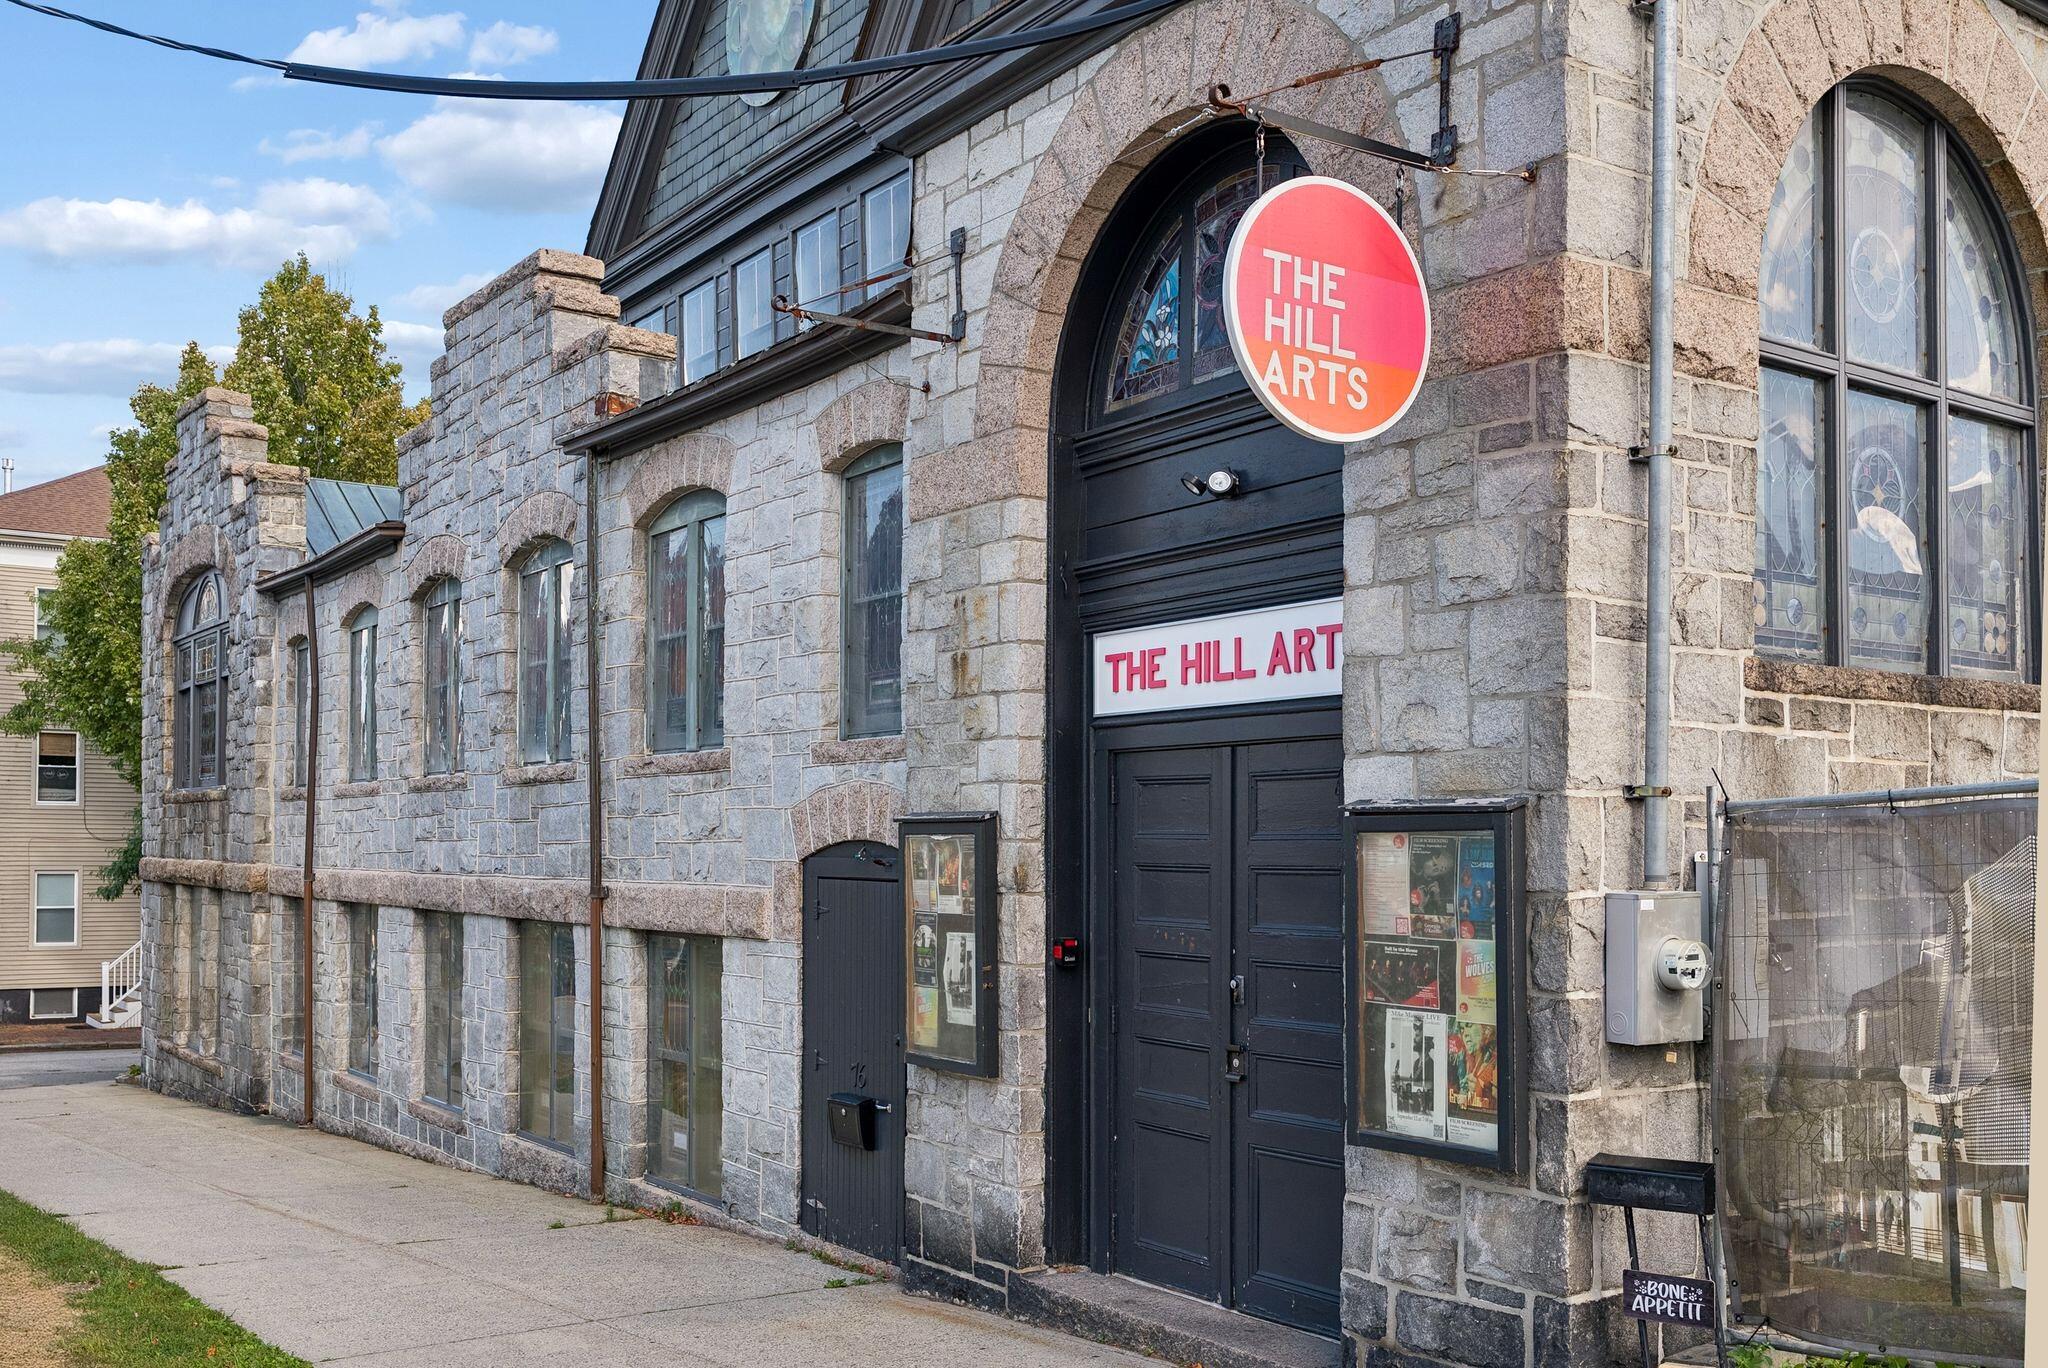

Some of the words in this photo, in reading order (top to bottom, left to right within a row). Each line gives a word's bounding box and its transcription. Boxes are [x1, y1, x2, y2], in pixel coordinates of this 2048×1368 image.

[1263, 248, 1345, 310] THE
[1264, 298, 1356, 360] HILL
[1262, 350, 1368, 410] ARTS
[1105, 647, 1167, 693] THE
[1181, 636, 1256, 685] HILL
[1465, 961, 1496, 978] WOLVES
[1632, 1294, 1706, 1321] APPETIT
[1647, 1280, 1689, 1301] BONE
